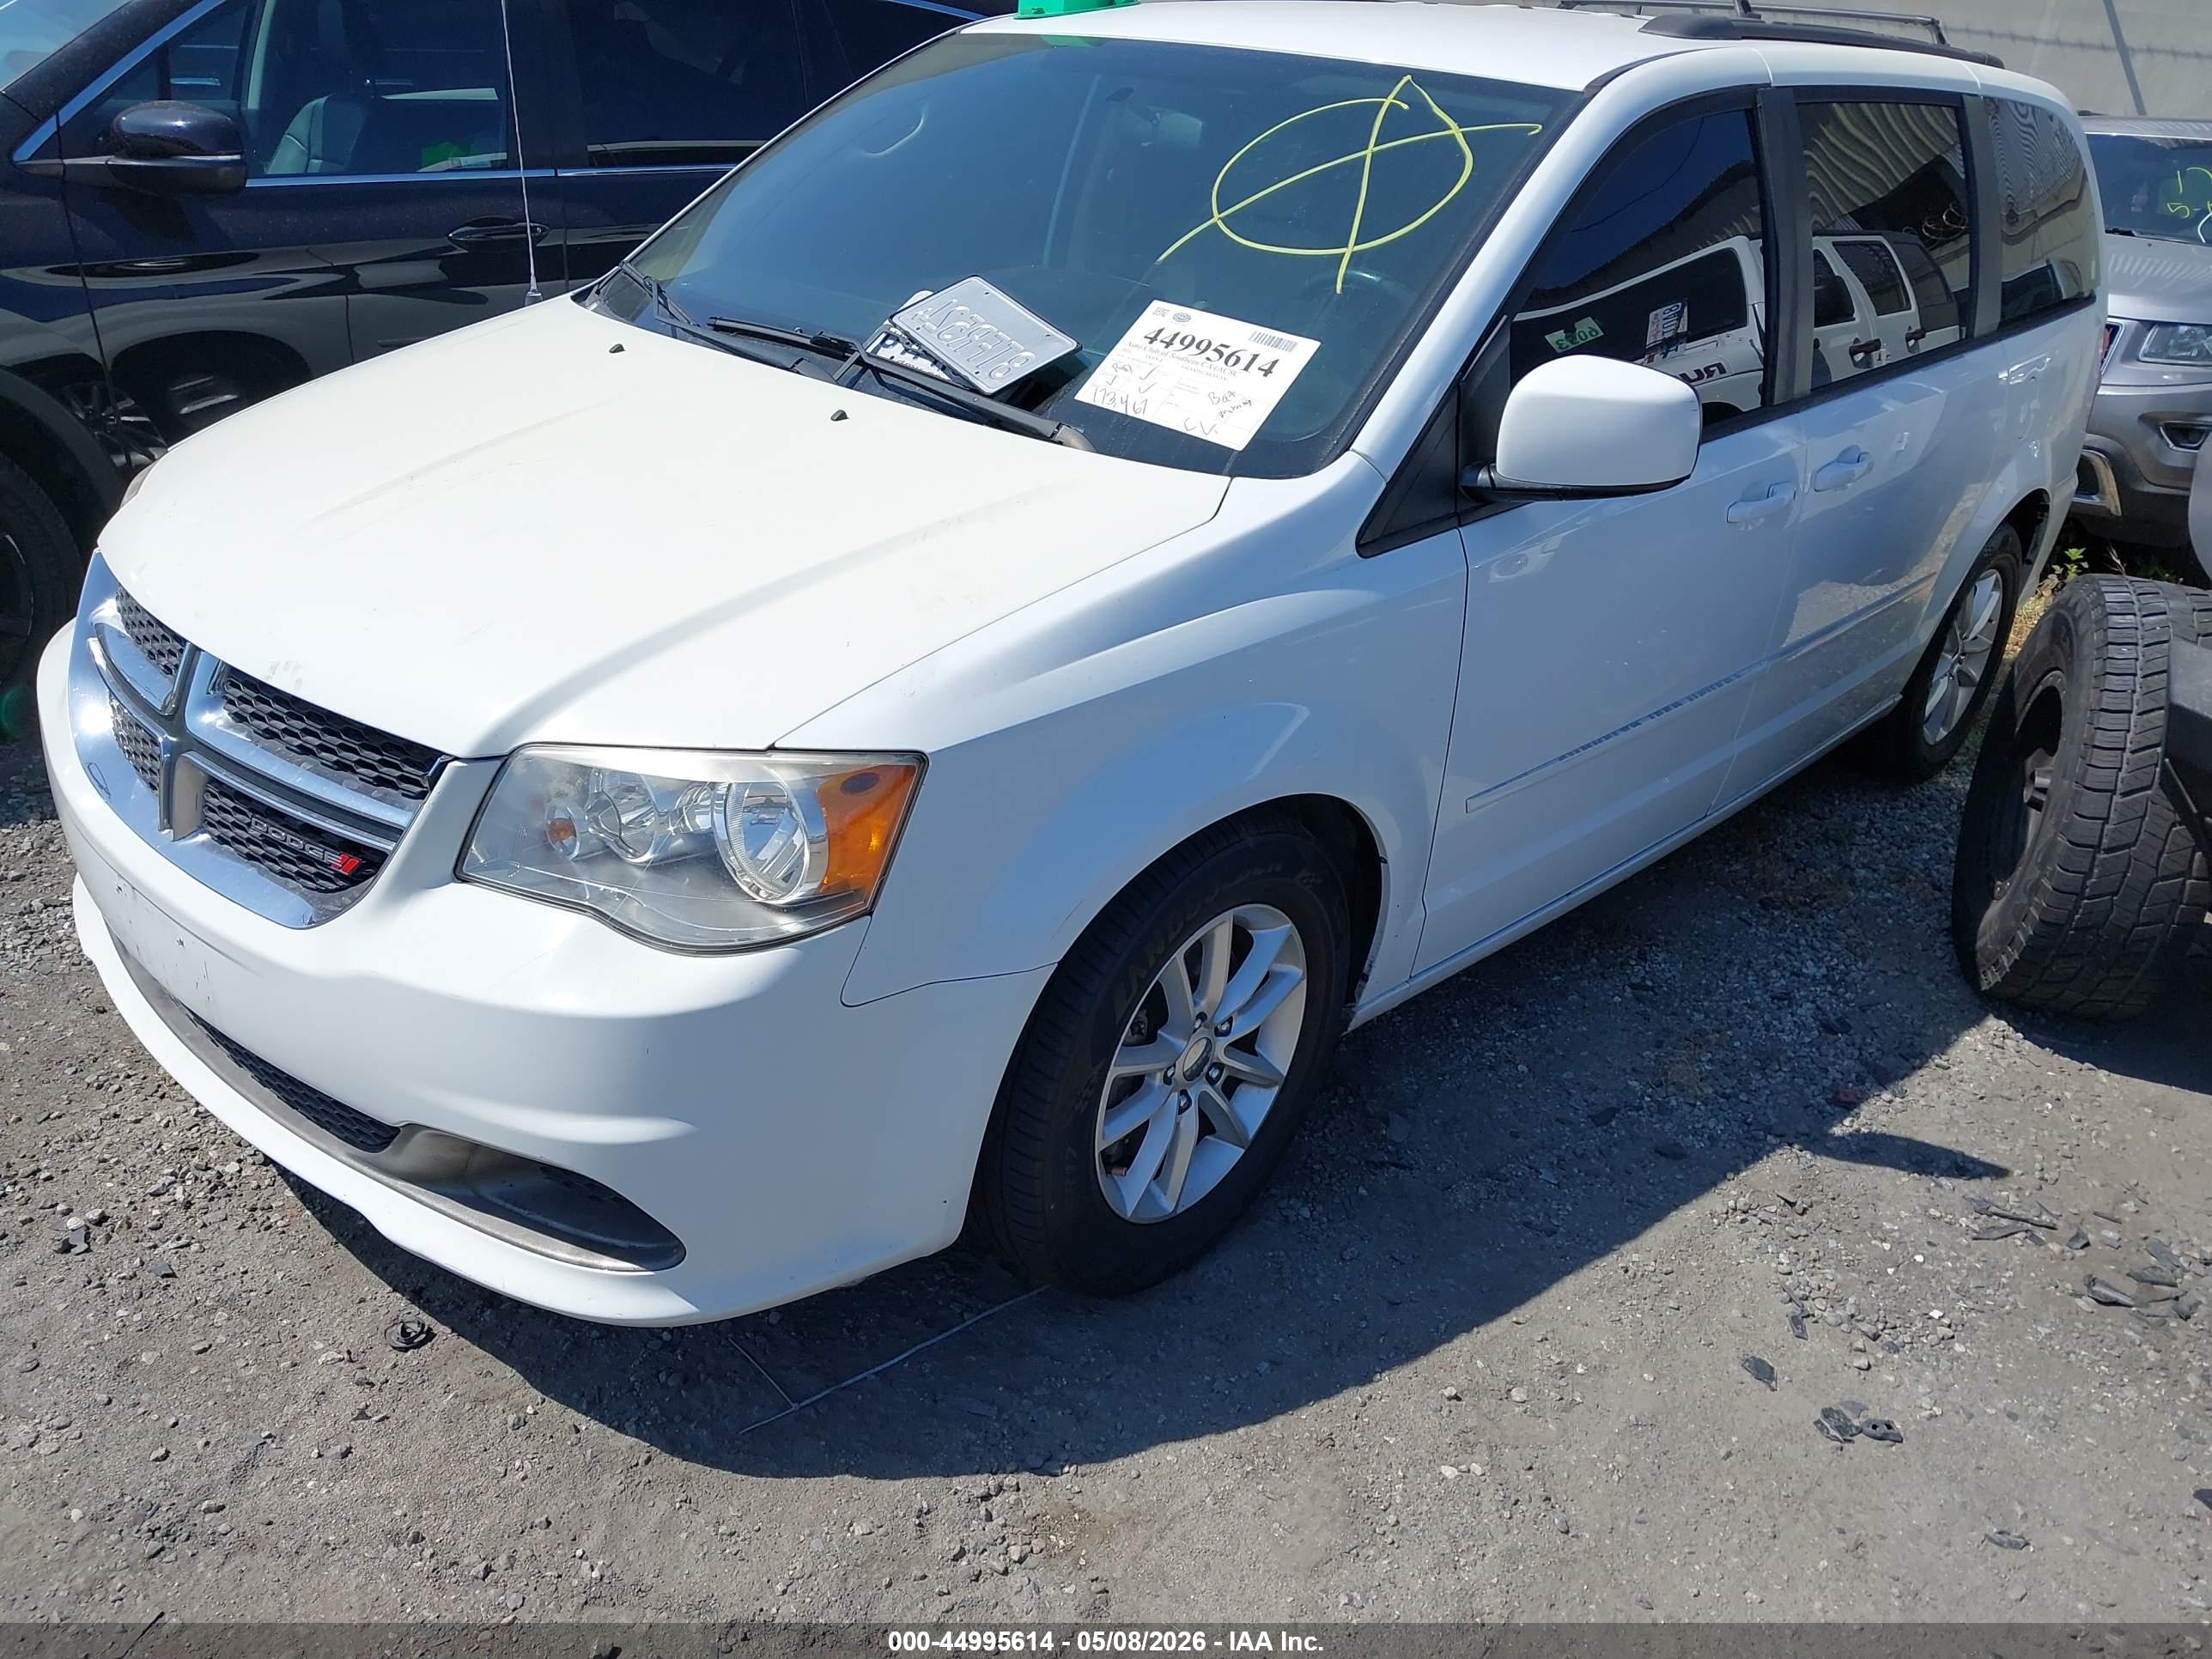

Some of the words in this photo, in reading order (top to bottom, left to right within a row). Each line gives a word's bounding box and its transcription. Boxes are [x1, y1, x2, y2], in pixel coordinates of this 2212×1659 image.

[1143, 326, 1280, 378] 44995614
[1143, 345, 1160, 355] Club
[1170, 353, 1200, 367] Southern
[251, 816, 342, 866] DODGE
